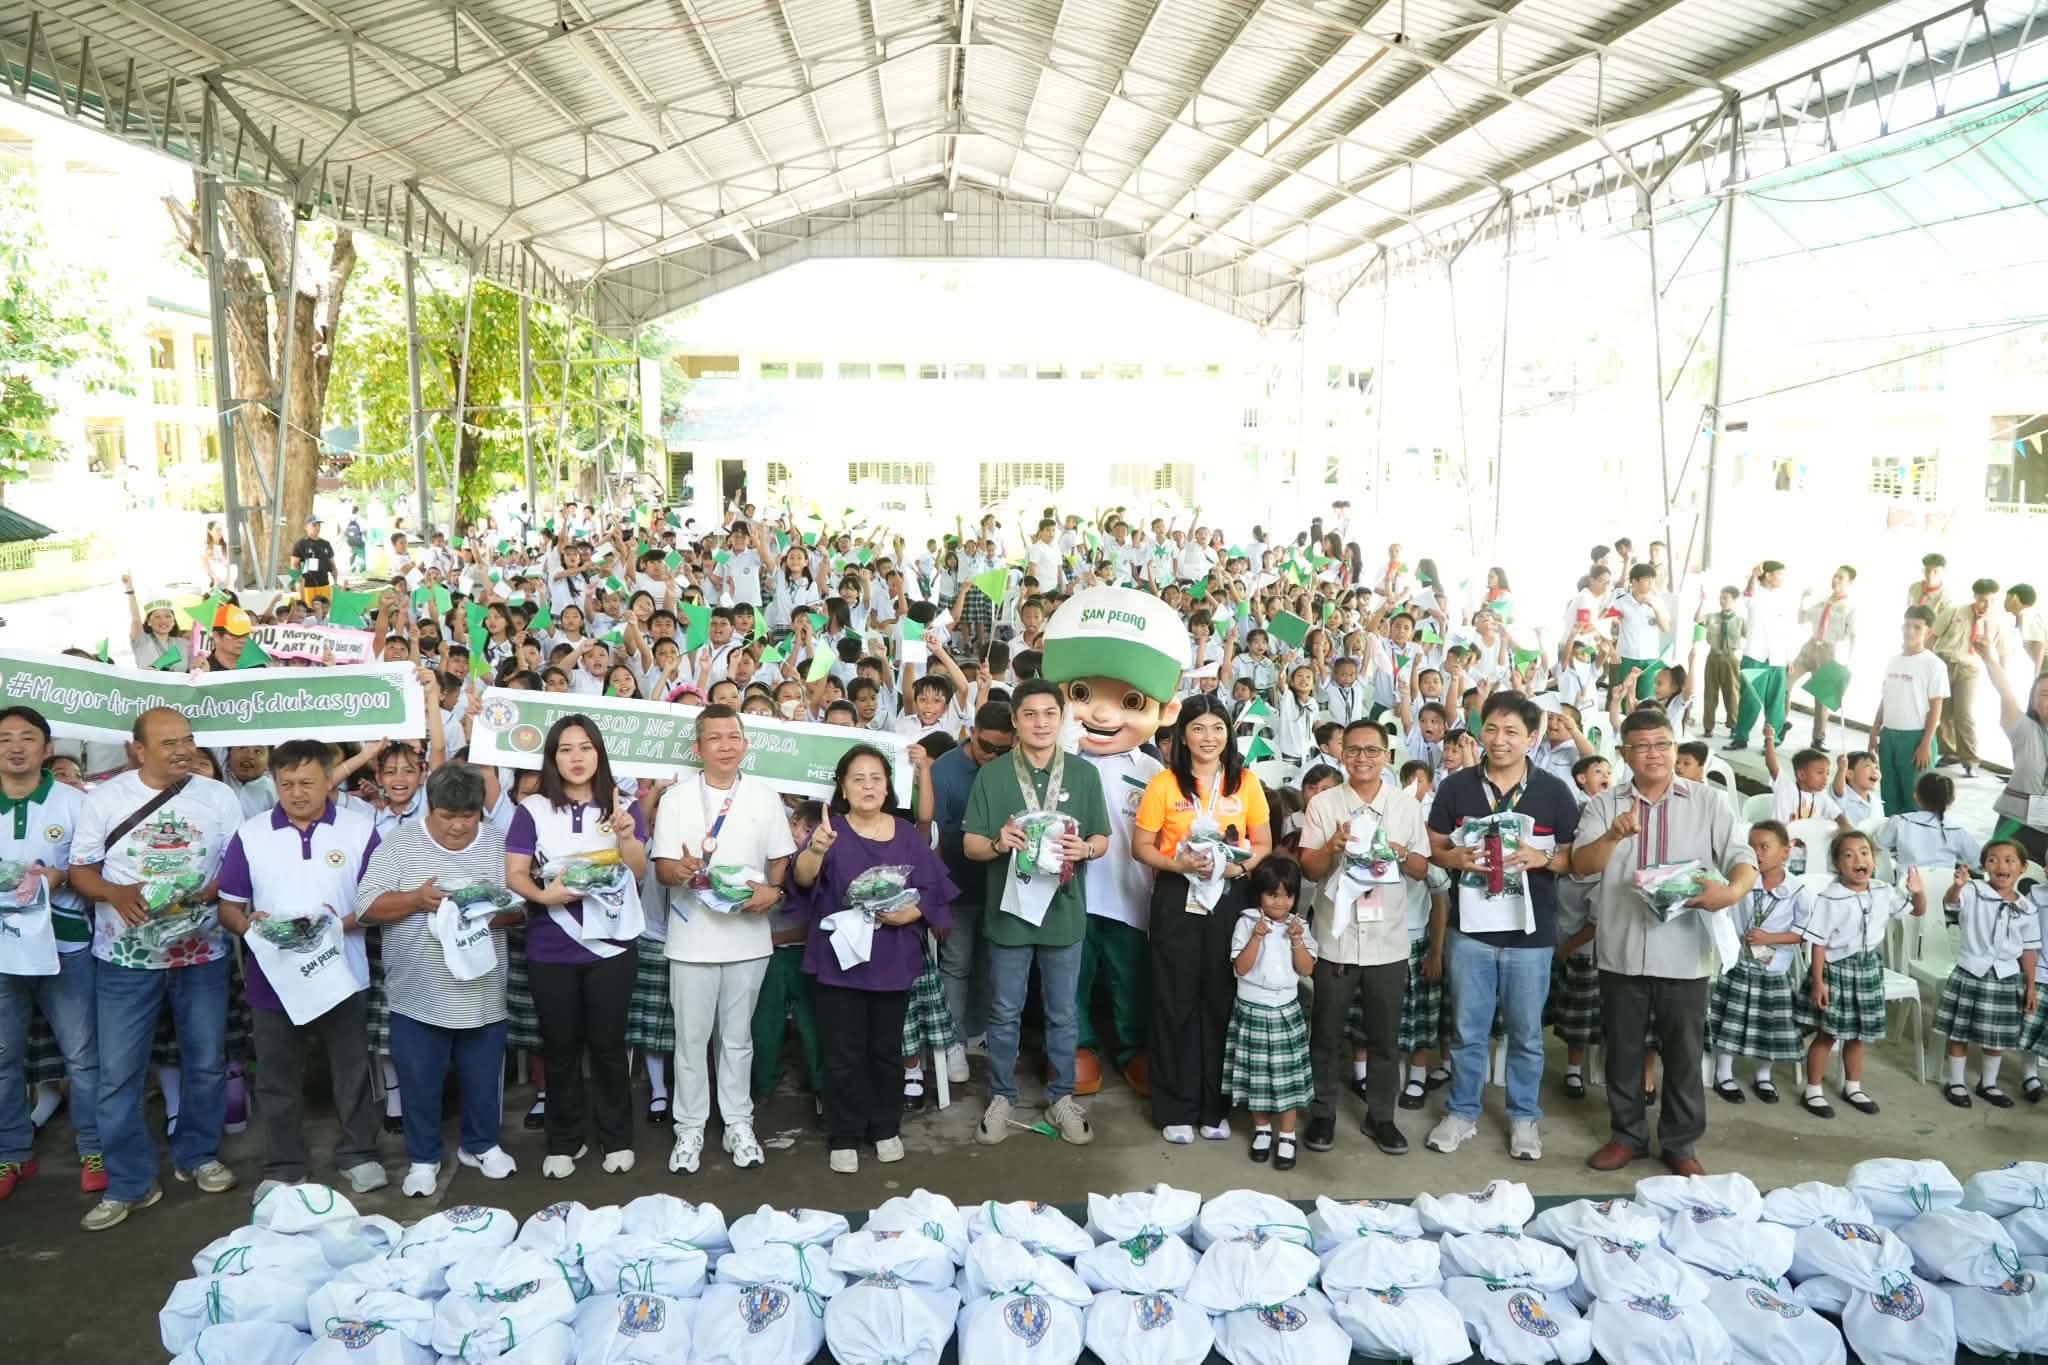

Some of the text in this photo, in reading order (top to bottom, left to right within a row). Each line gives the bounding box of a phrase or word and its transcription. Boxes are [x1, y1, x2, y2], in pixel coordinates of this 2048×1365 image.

[1081, 608, 1147, 631] SAN PEDRO
[282, 630, 324, 640] Mayor
[282, 642, 305, 652] ART
[300, 960, 318, 977] SAN
